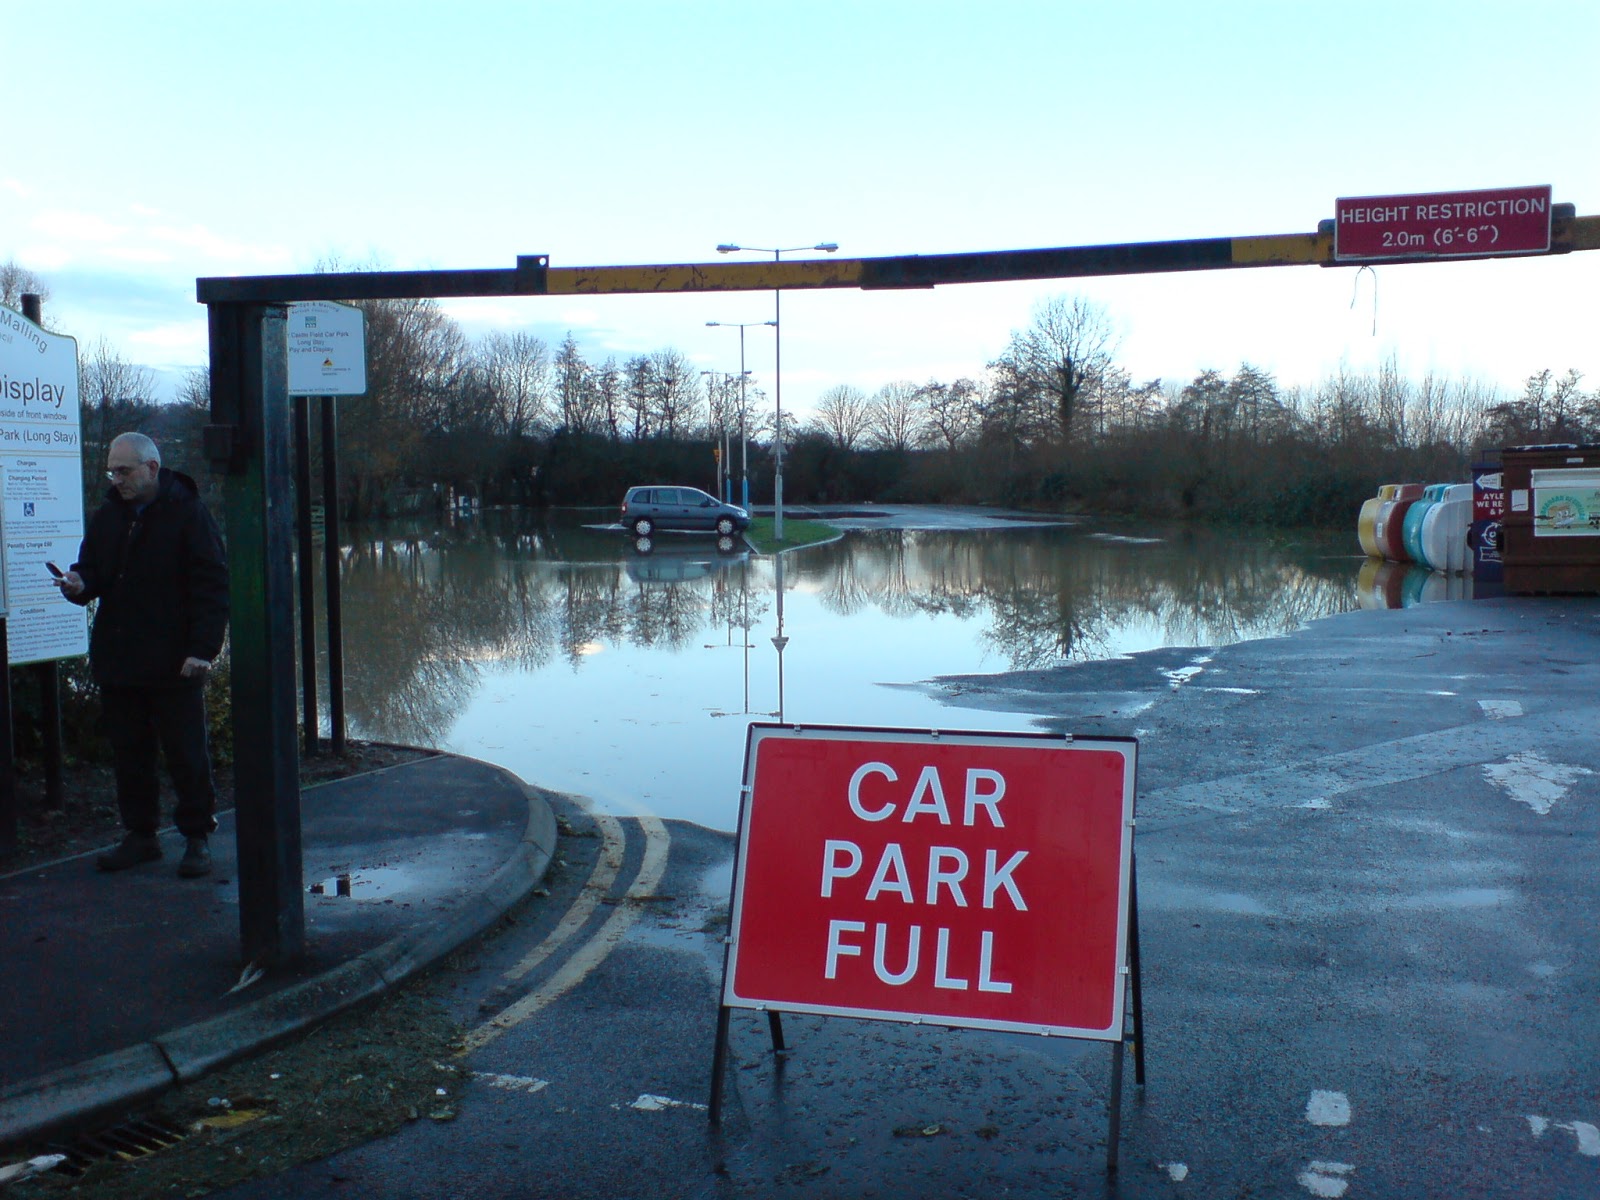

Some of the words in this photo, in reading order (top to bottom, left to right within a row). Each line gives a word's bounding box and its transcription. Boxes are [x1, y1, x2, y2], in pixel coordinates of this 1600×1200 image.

[1341, 206, 1409, 223] HEIGHT
[1416, 197, 1545, 220] RESTRICTION
[1382, 231, 1425, 247] 2.0m
[0, 310, 48, 354] Malling
[0, 374, 65, 409] isplay
[17, 410, 25, 418] of
[26, 410, 42, 419] front
[43, 412, 68, 421] window
[23, 429, 51, 445] (Long
[53, 430, 78, 445] Stay)
[848, 761, 1007, 828] CAR
[820, 839, 1030, 912] PARK
[824, 919, 1013, 994] FULL
